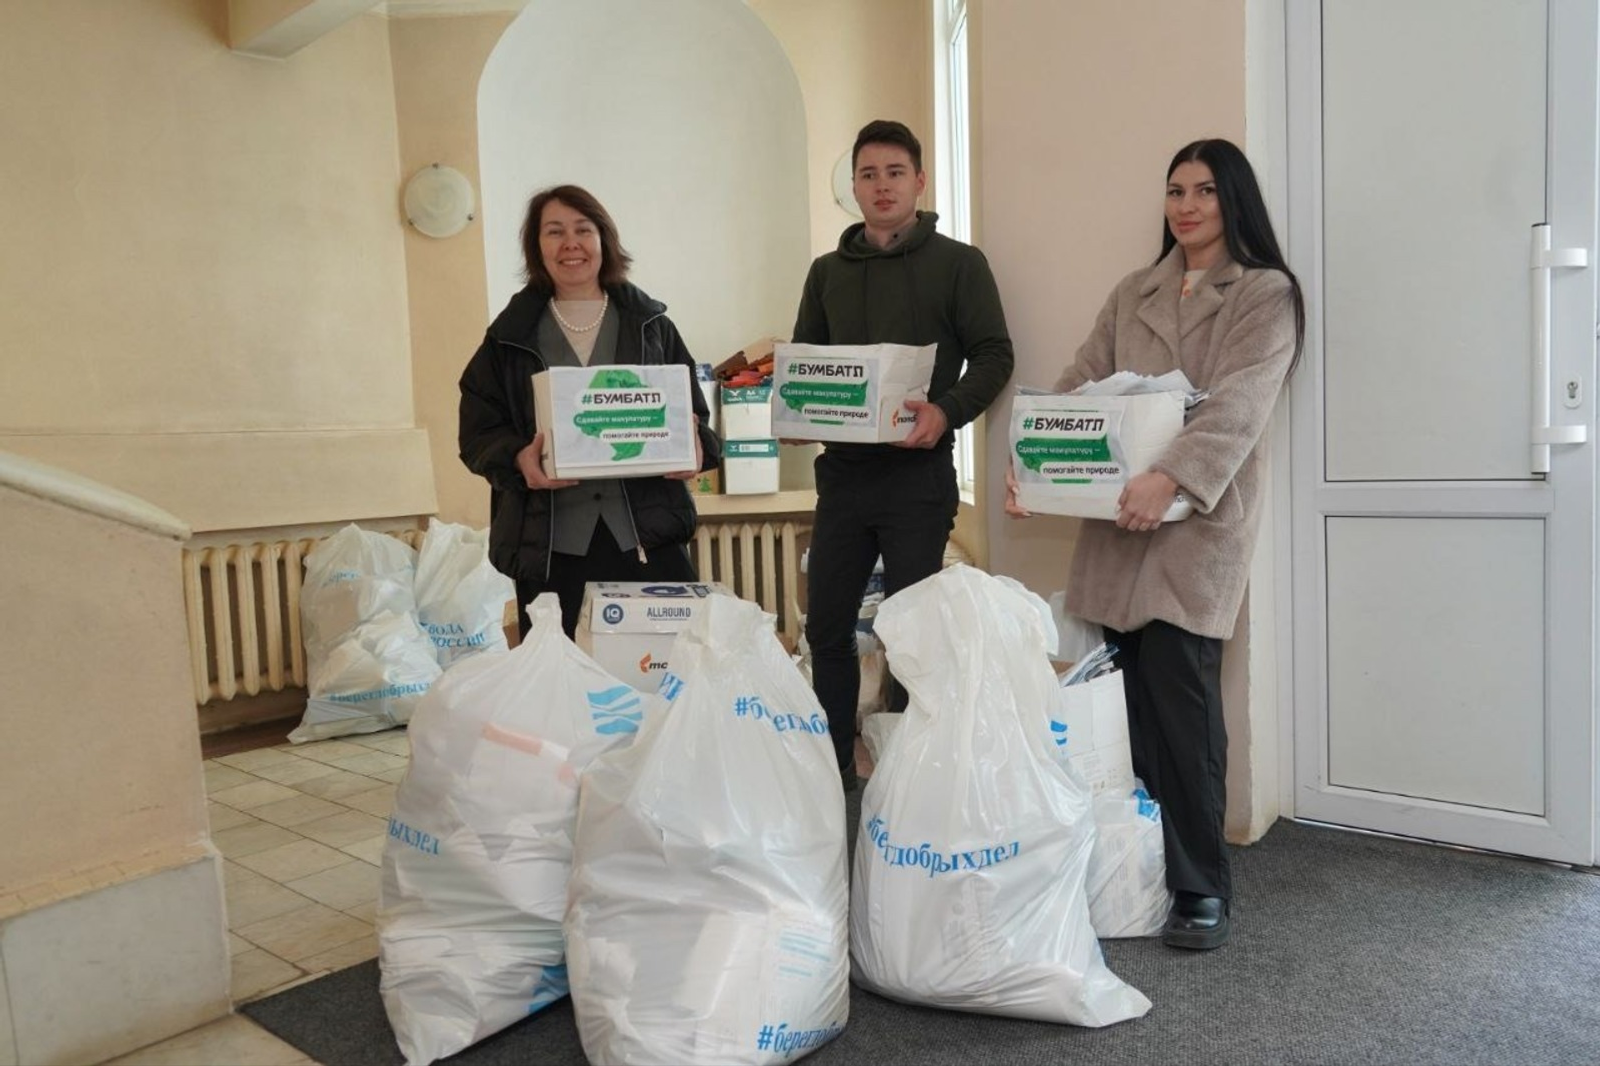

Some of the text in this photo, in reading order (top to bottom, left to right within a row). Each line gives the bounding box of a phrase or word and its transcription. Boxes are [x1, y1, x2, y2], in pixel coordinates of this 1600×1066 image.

[812, 390, 852, 399] макулатуру
[804, 408, 839, 417] помогайте
[602, 432, 639, 440] помогайте
[1049, 446, 1093, 455] макулатуру
[1042, 465, 1120, 475] помогайте природе
[606, 608, 620, 618] IQ
[646, 607, 691, 618] ALLROUND
